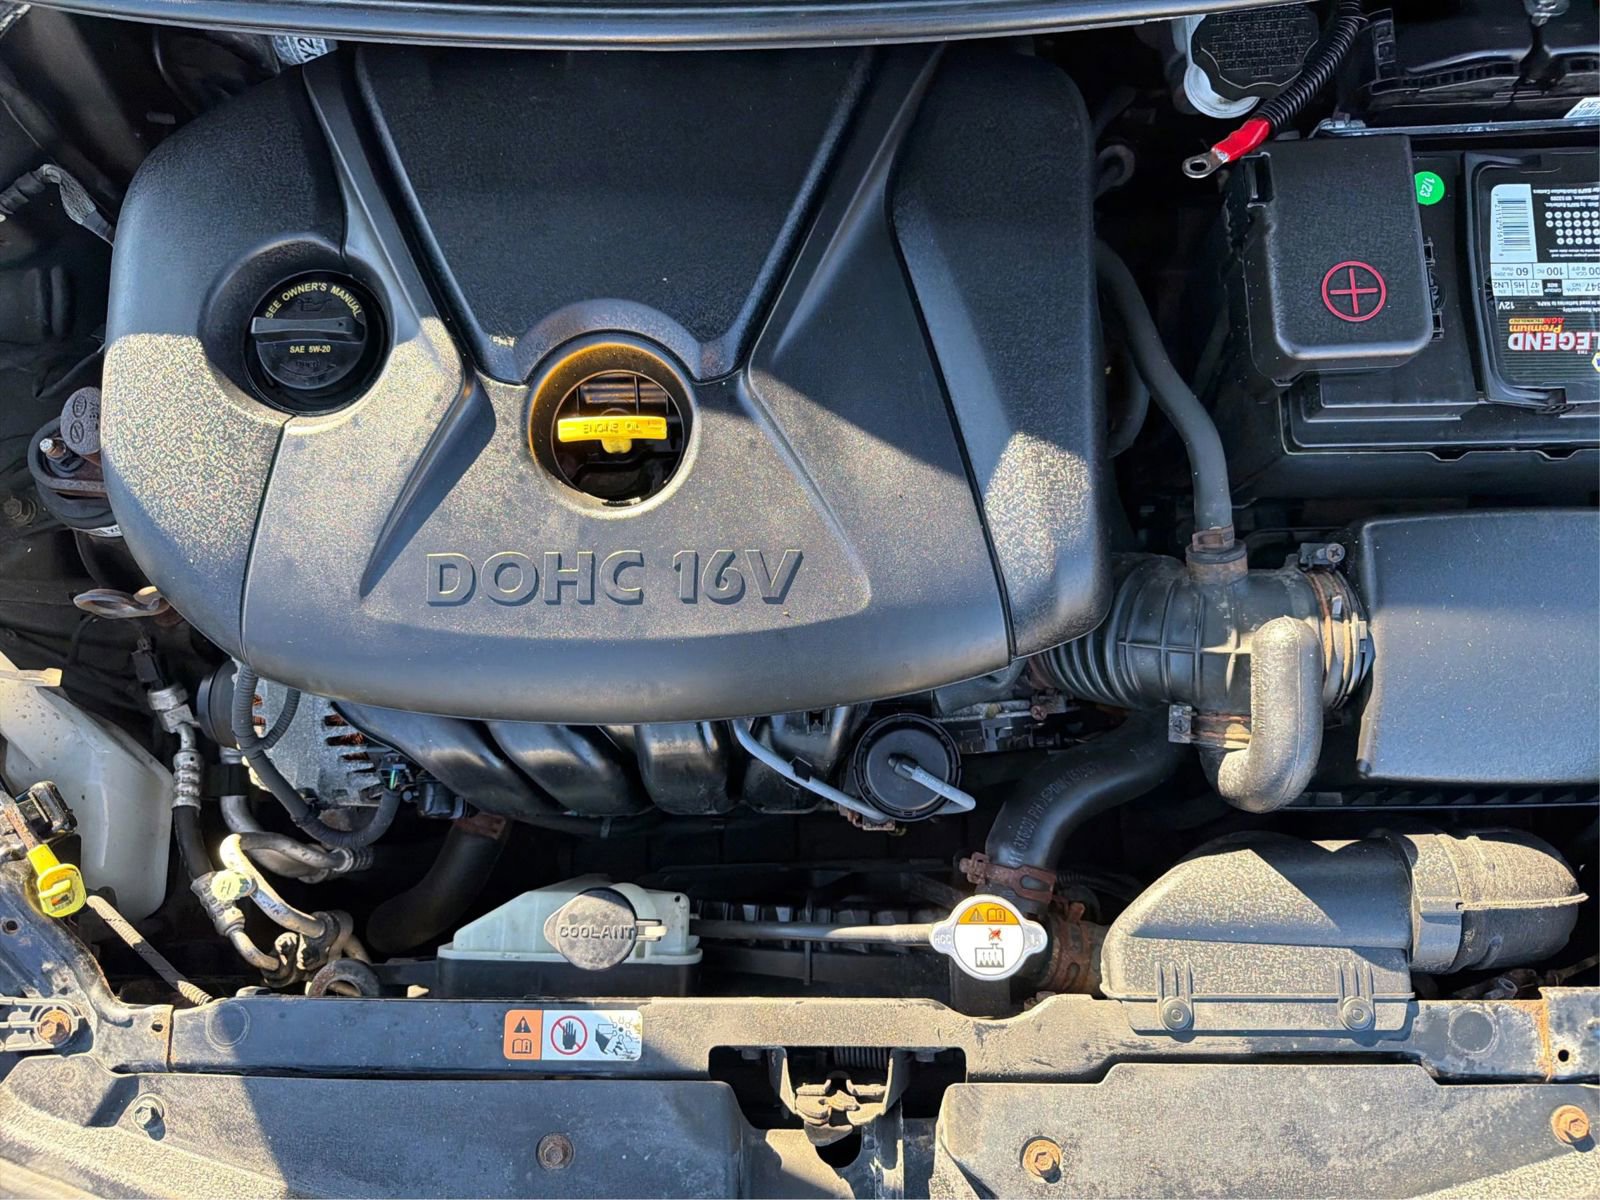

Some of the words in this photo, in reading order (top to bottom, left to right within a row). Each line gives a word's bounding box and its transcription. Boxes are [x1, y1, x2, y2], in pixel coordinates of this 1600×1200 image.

[1419, 177, 1436, 198] 1/23
[1516, 267, 1529, 276] 60
[1546, 267, 1564, 276] 100
[1530, 281, 1540, 289] 47
[264, 299, 282, 319] SEE
[281, 282, 328, 301] OWNER'S
[330, 285, 362, 318] MANUAL
[1498, 301, 1516, 310] 12V
[1509, 324, 1563, 334] Premium
[1507, 331, 1600, 351] LEGEND
[289, 345, 305, 354] SAE
[308, 344, 332, 354] 5W-20
[425, 550, 645, 607] DOHC
[672, 548, 804, 605] 16V
[559, 923, 636, 941] COOLANT
